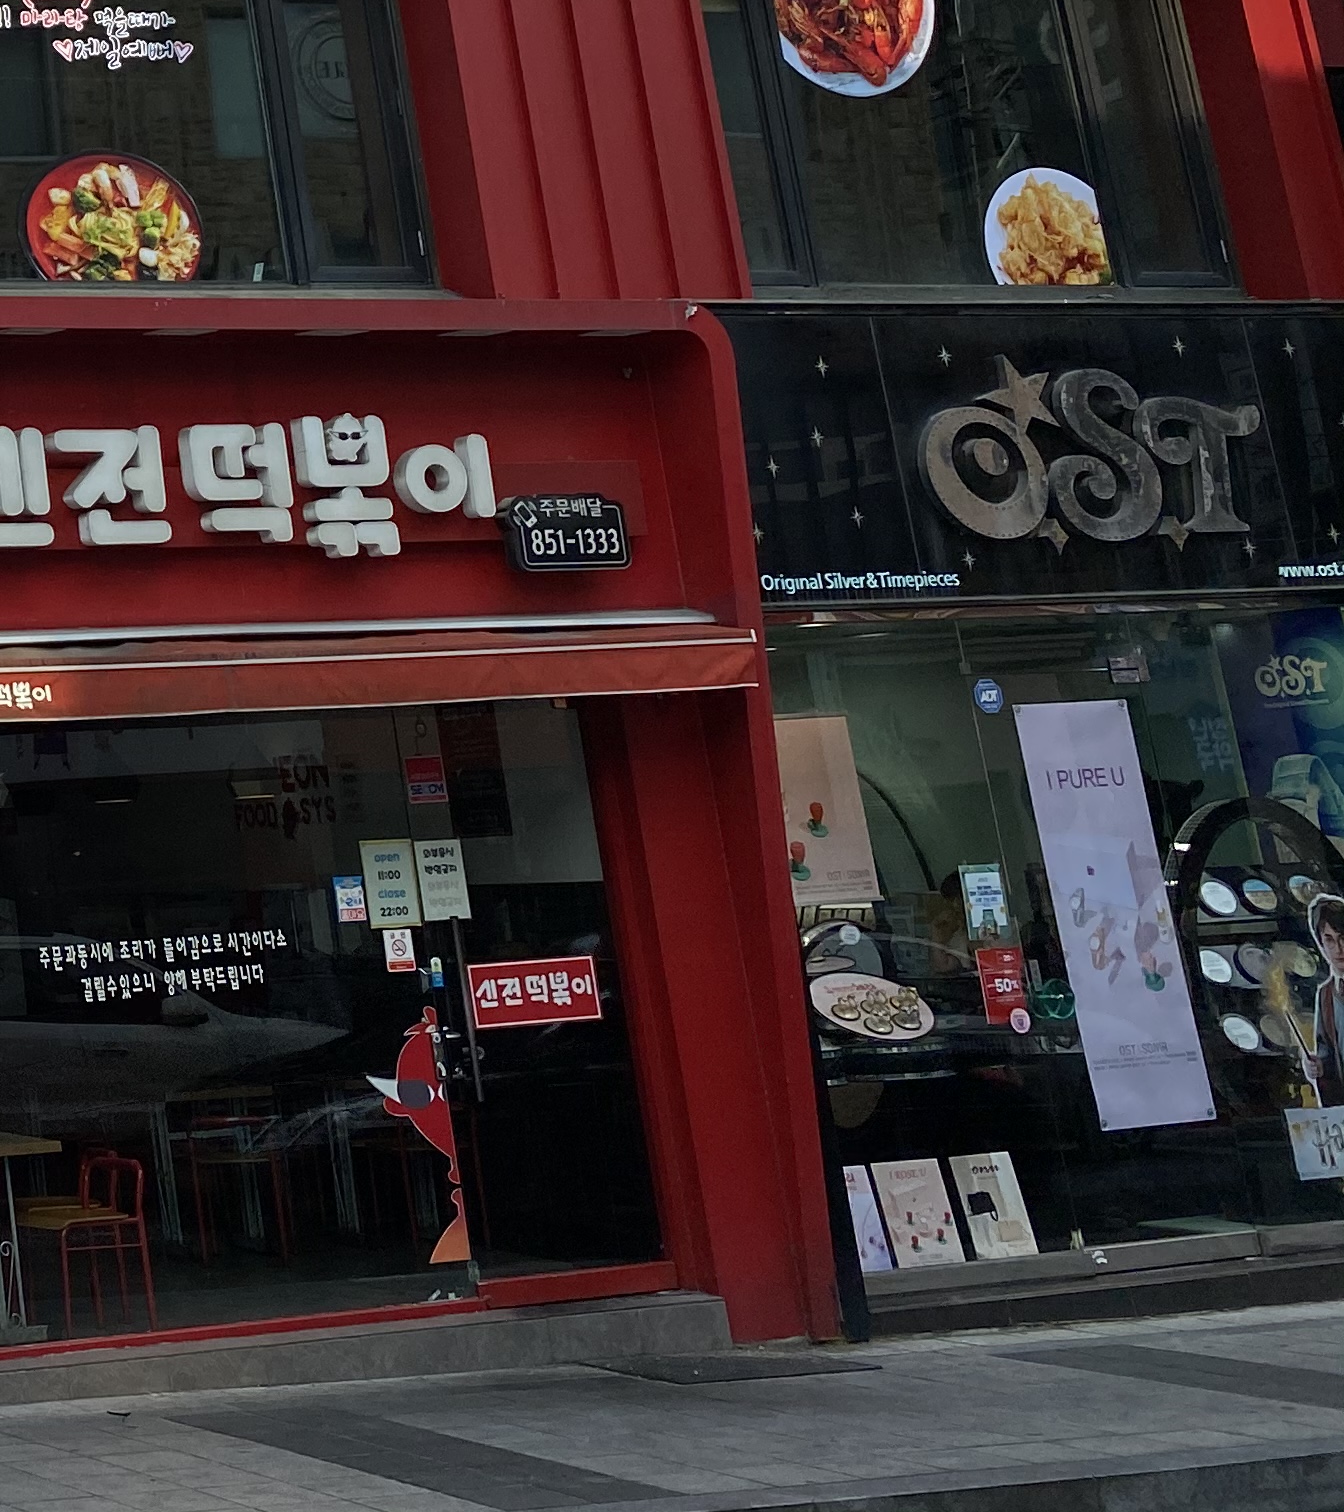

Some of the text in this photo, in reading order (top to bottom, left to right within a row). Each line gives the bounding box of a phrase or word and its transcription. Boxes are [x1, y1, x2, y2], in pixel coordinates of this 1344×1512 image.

[539, 497, 603, 518] 주문배달
[530, 527, 620, 556] 851-1333
[761, 572, 823, 595] Original
[980, 689, 998, 703] ADT
[1055, 767, 1109, 789] PURE
[1109, 765, 1125, 787] U
[373, 852, 401, 864] open
[377, 869, 401, 881] 11:00
[377, 887, 407, 899] close
[379, 905, 409, 917] 22:00
[38, 941, 114, 972] 주문과동시에
[118, 938, 157, 960] 조리가
[227, 928, 288, 957] 시간이다소
[163, 969, 188, 996] 양해
[190, 963, 265, 993] 부탁드립니다
[475, 971, 593, 1009] 신전떡볶이
